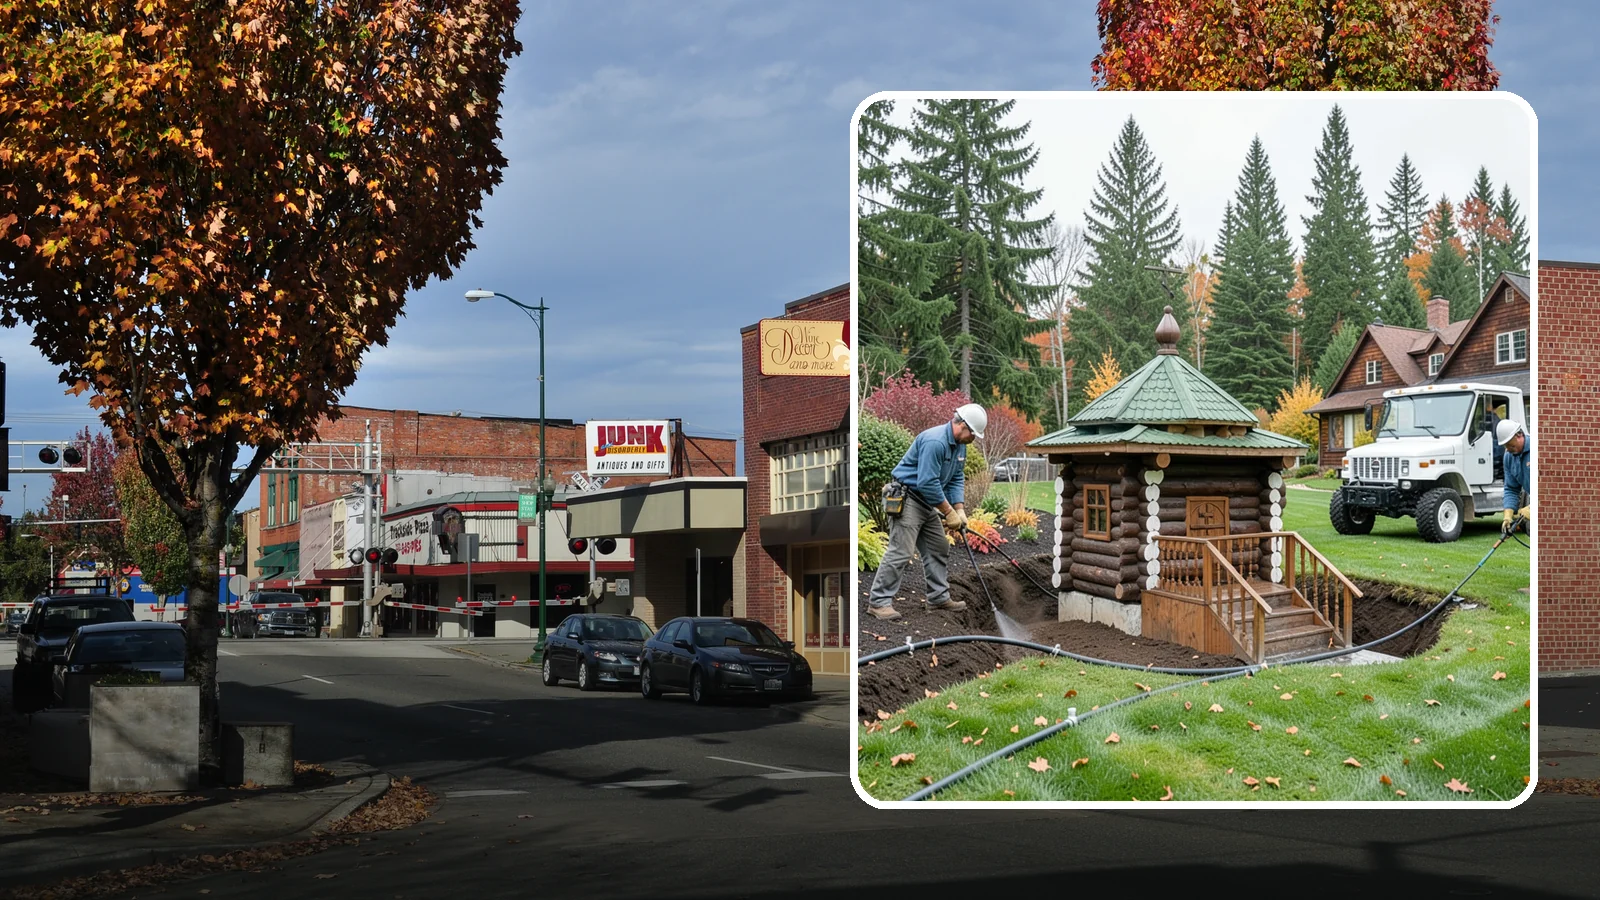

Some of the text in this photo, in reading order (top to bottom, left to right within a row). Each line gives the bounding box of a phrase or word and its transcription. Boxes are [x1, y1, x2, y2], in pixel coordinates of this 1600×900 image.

[596, 425, 665, 457] JUNK
[596, 460, 665, 470] ANTIQUES AND GIFTS
[414, 520, 428, 534] Pizza
